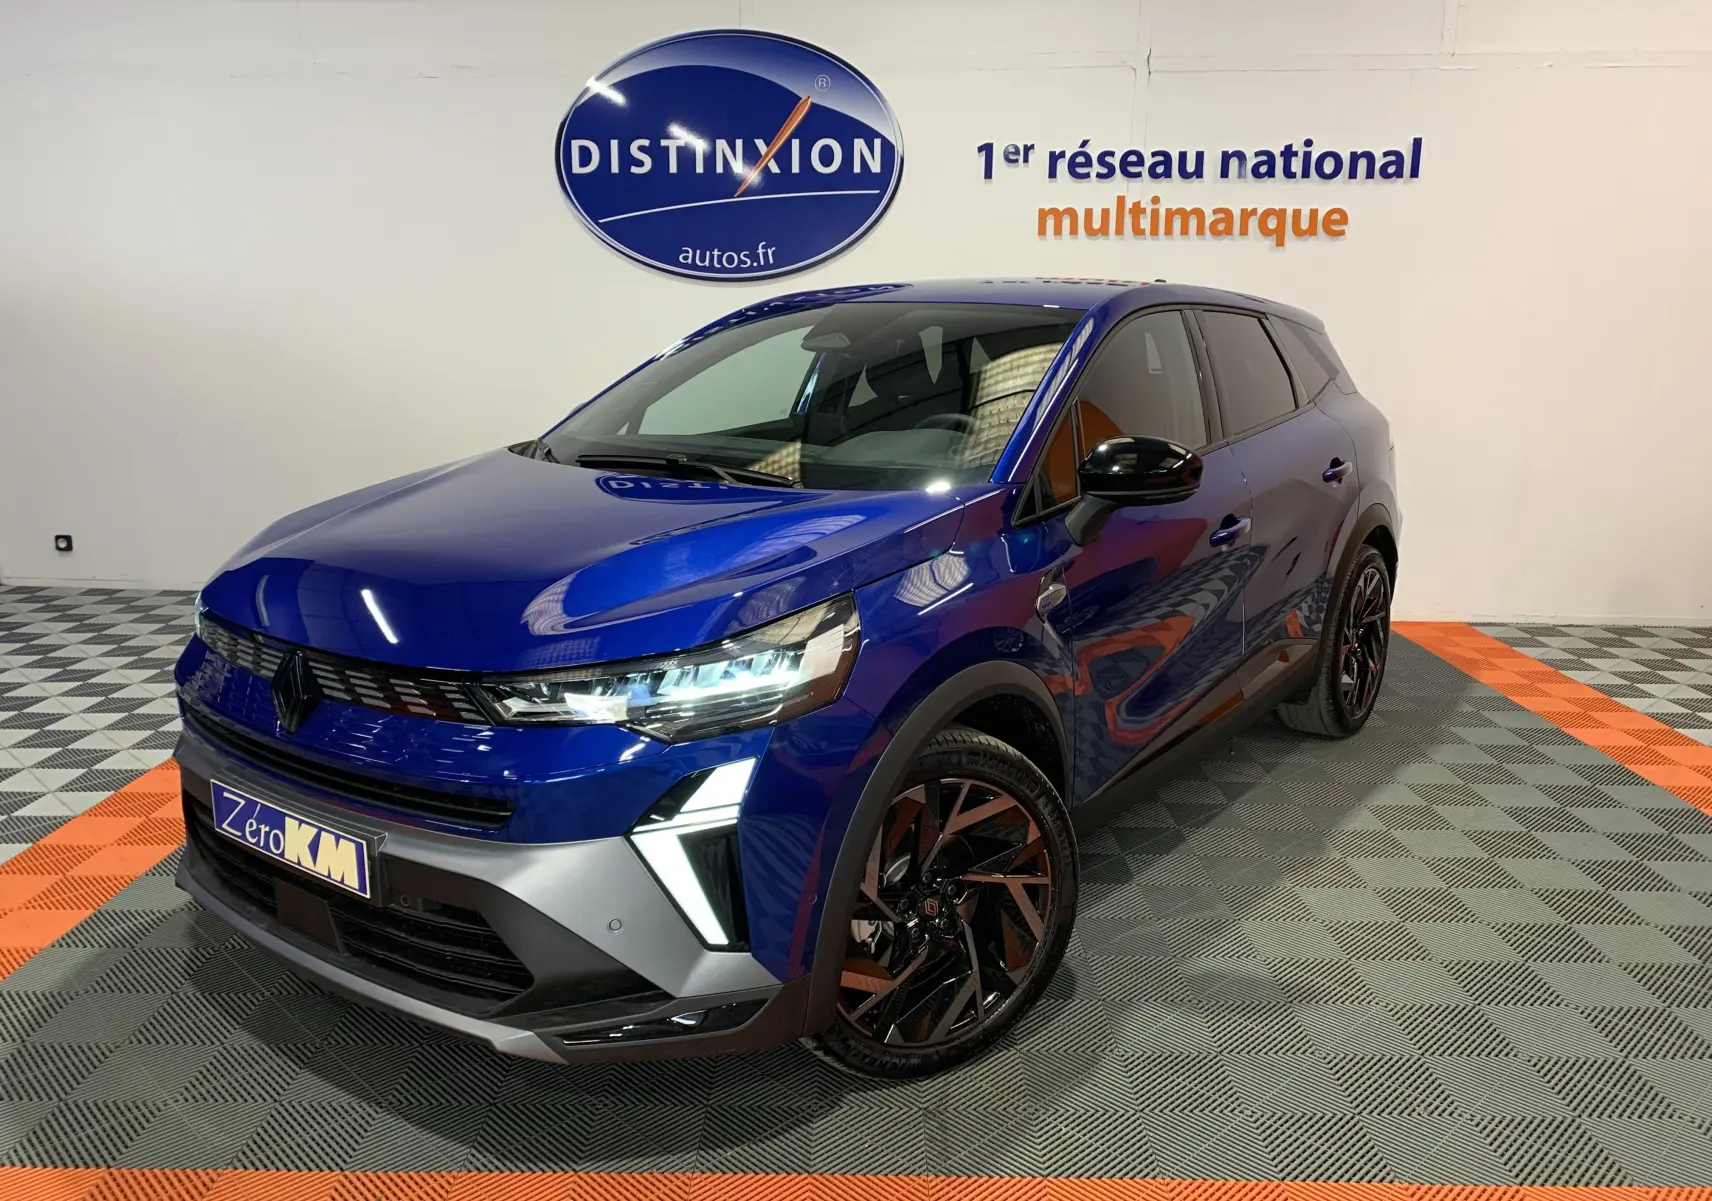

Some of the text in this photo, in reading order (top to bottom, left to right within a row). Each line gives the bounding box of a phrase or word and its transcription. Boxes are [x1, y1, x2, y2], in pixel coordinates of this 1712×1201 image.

[570, 137, 882, 175] DISTINXION
[976, 137, 1423, 180] 1er réseau national
[1036, 195, 1349, 247] multimarque
[678, 242, 777, 268] autos.fr
